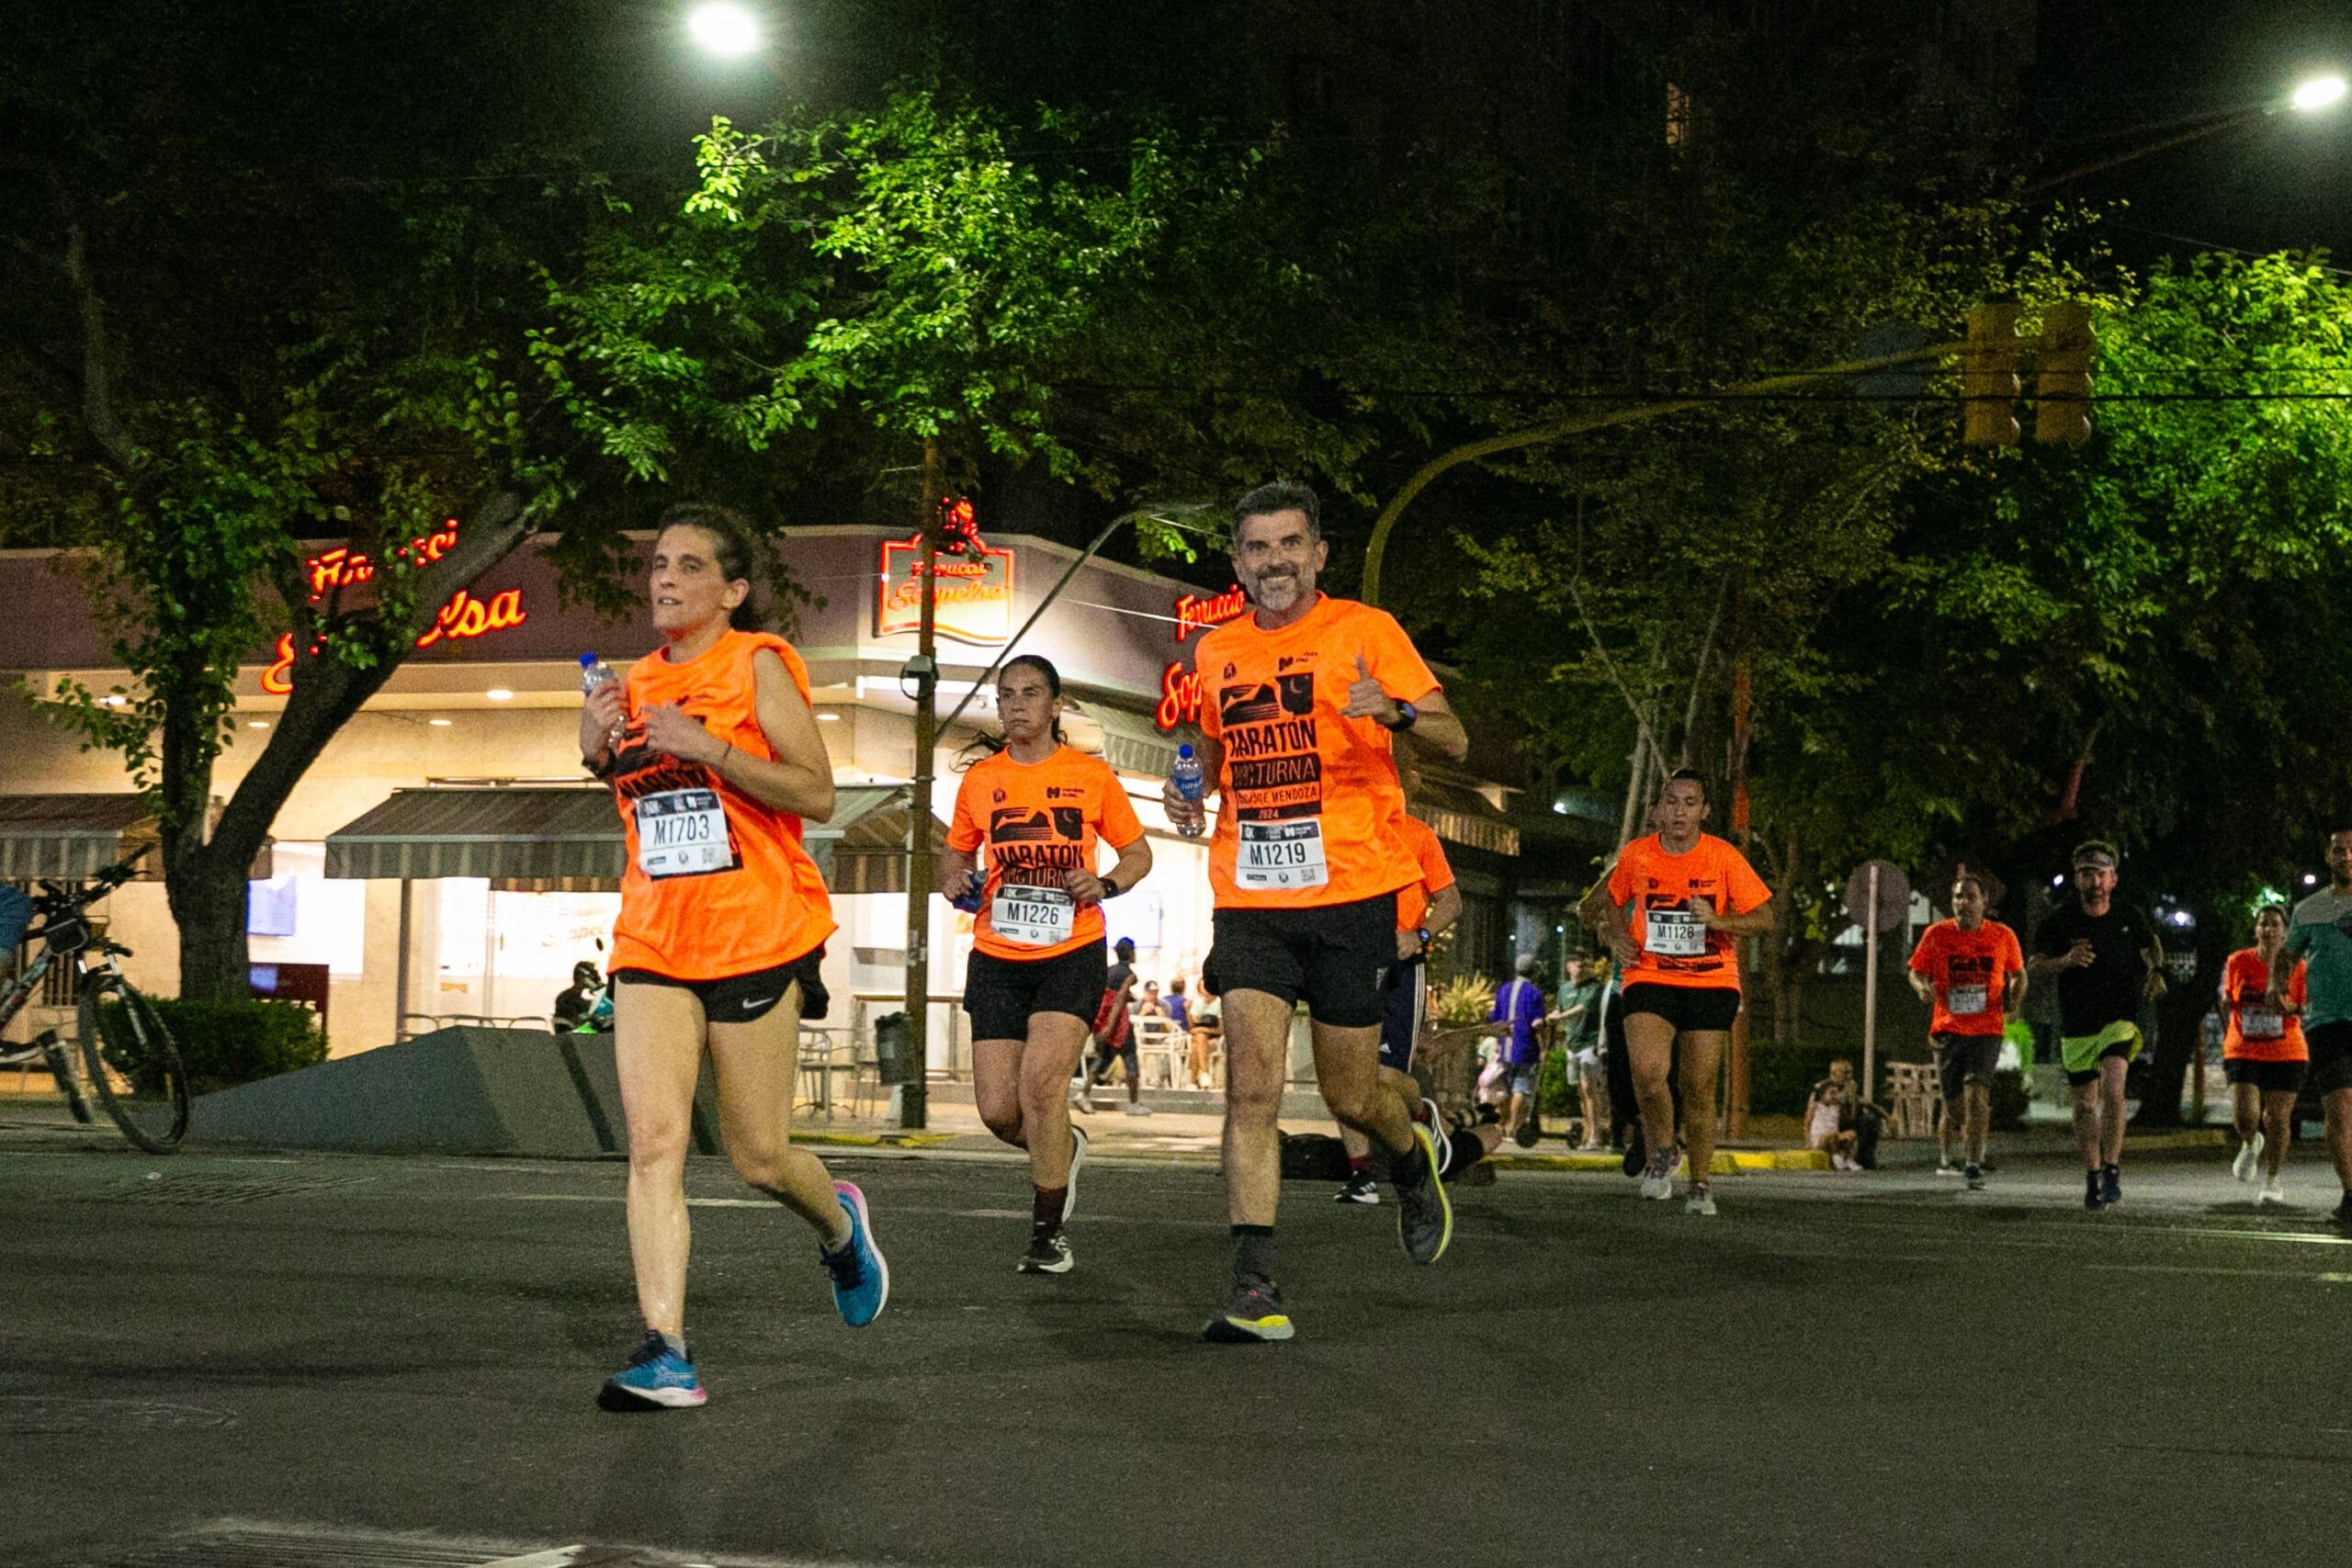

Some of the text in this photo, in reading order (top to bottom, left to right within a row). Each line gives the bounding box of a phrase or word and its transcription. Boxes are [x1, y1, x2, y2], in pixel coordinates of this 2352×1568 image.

[1272, 786, 1317, 803] MENDOZA
[653, 814, 710, 846] M1703
[1250, 842, 1306, 865] M1219
[1007, 902, 1059, 925] M1226
